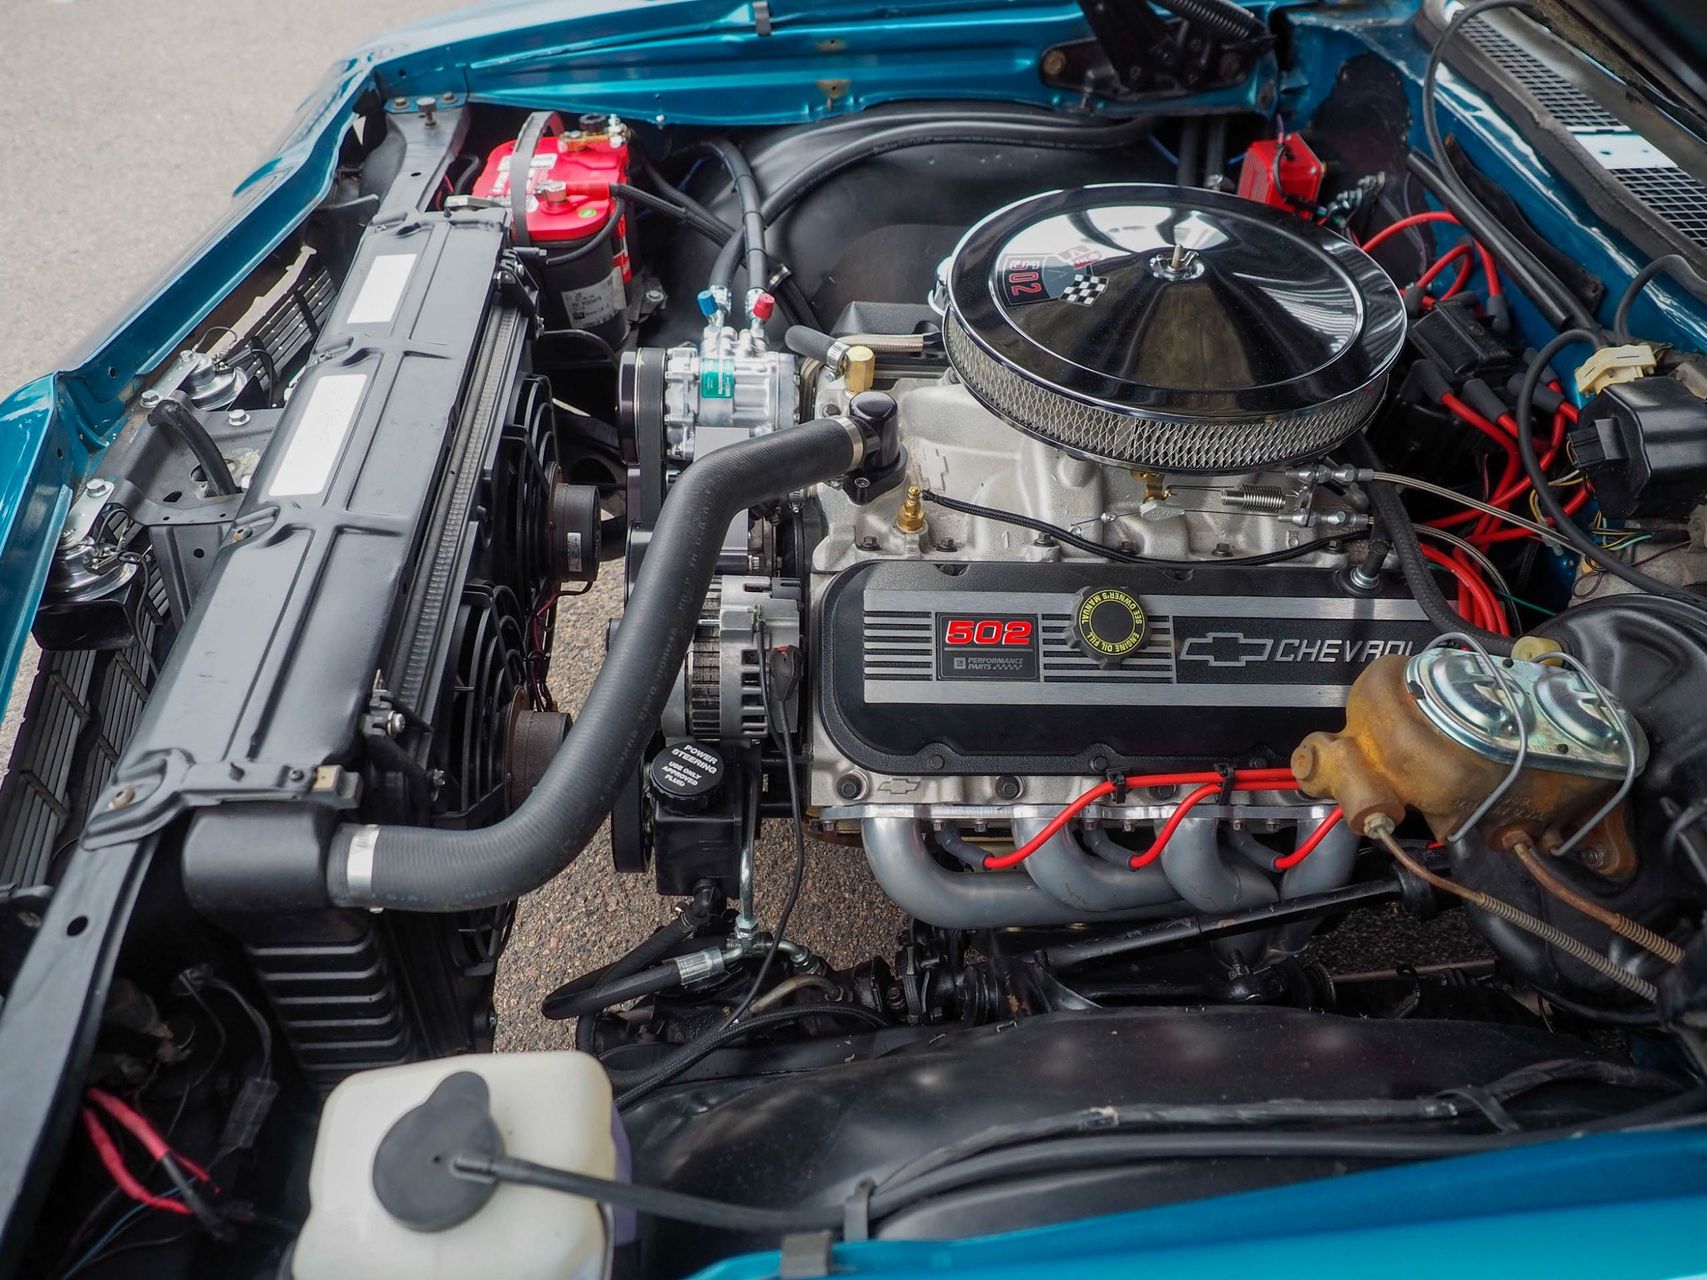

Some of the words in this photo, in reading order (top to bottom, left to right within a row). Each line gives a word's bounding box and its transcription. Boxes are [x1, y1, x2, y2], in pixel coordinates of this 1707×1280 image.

[1009, 260, 1042, 297] 502
[1081, 594, 1102, 625] MANUAL
[1101, 591, 1137, 610] OWNER'S
[1133, 610, 1143, 625] SEE
[945, 620, 1032, 645] 502
[1087, 631, 1101, 647] FILL
[1115, 632, 1140, 652] ENGINE
[1101, 644, 1113, 652] OIL
[967, 657, 1024, 665] PERFORMANCE
[967, 663, 992, 671] PARTS
[671, 748, 718, 775] STEERING
[683, 744, 718, 765] POWER
[661, 765, 699, 786] APPROVED
[664, 773, 686, 787] FLUID
[668, 760, 684, 771] USE
[682, 767, 702, 780] ONLY
